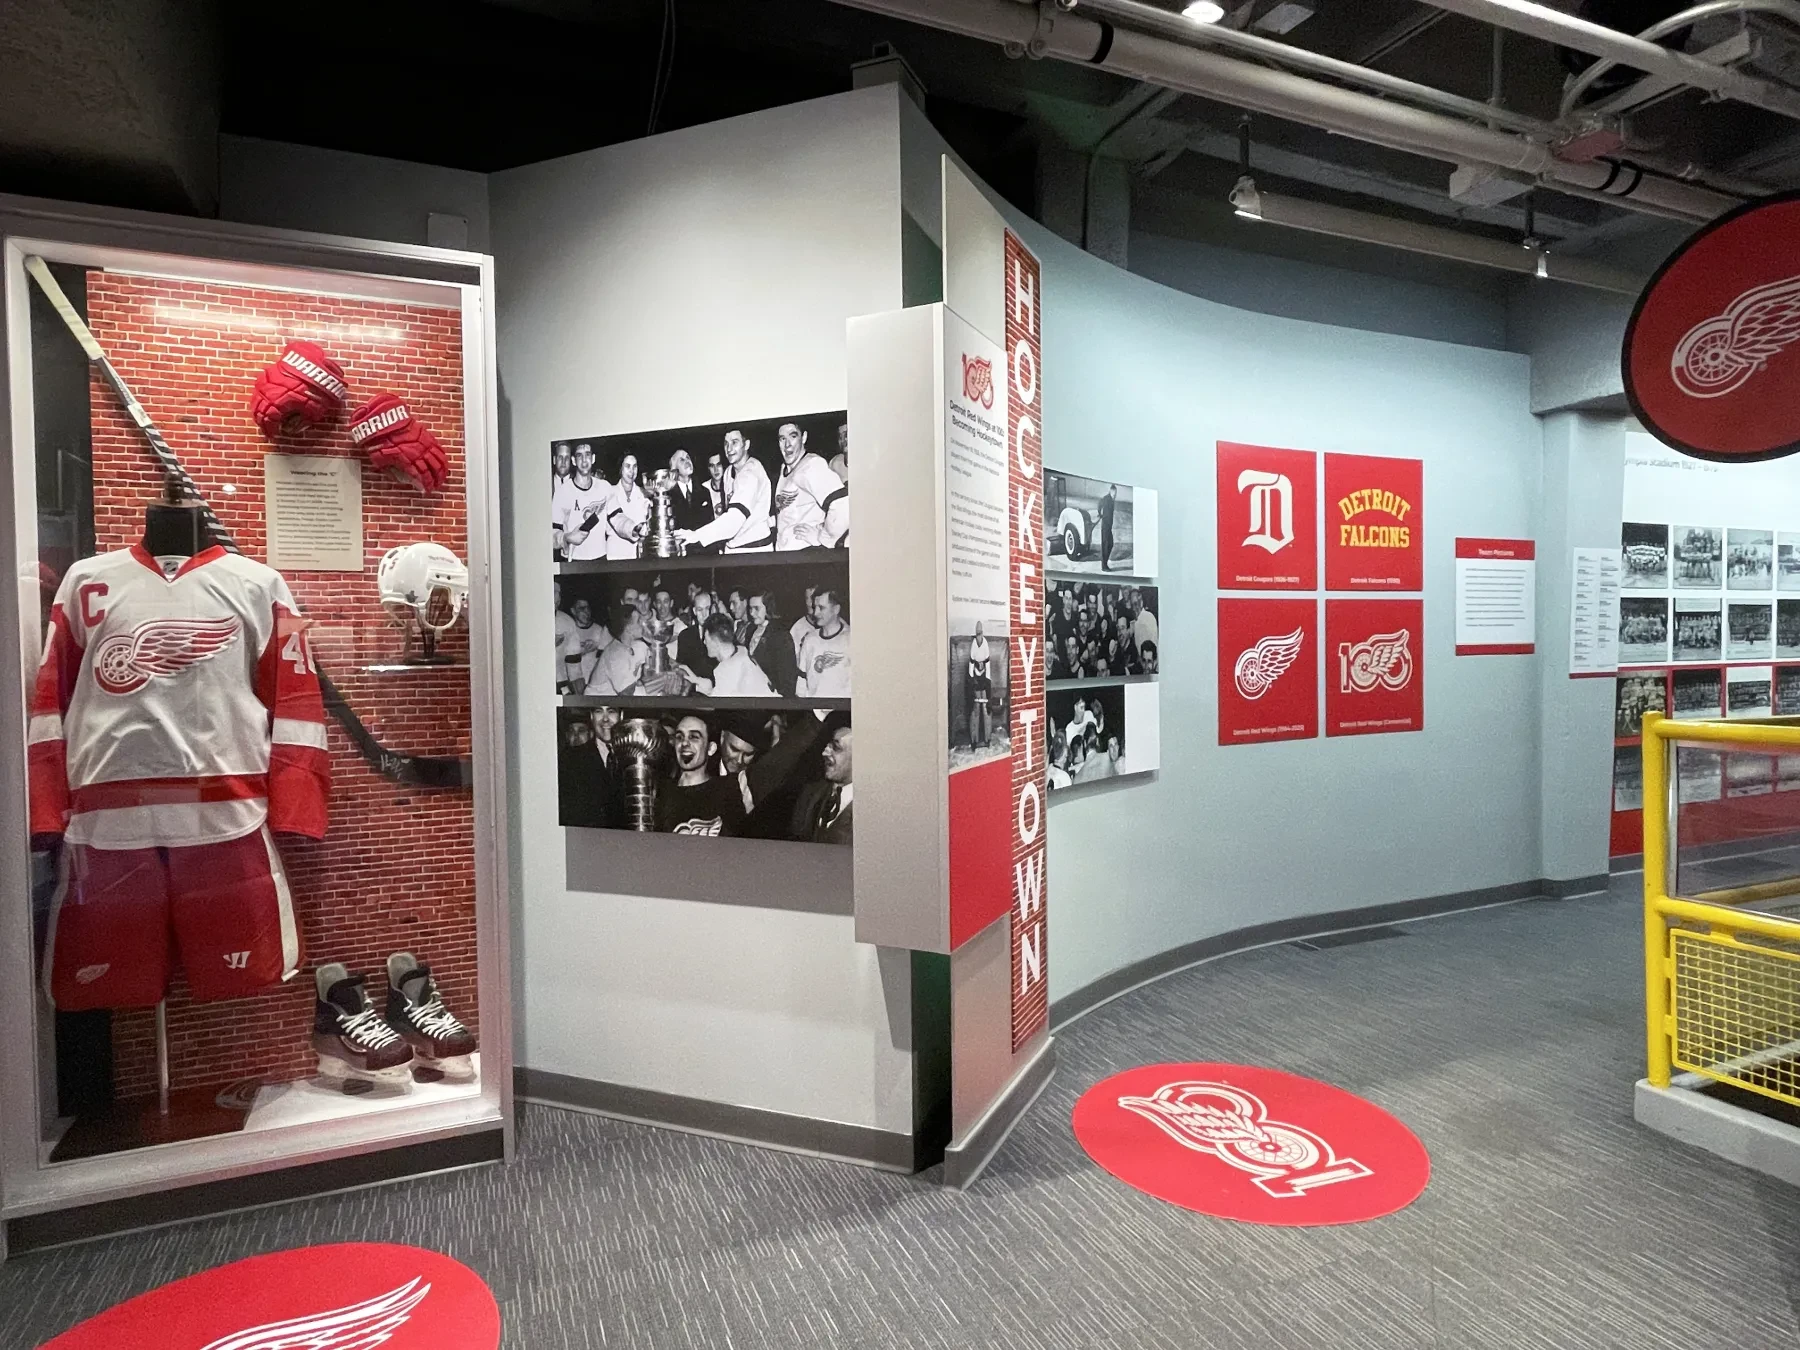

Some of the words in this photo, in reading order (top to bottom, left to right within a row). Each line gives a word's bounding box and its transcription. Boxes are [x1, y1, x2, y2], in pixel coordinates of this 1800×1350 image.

[1338, 489, 1411, 521] DETROIT
[1340, 525, 1410, 548] FALCONS
[79, 582, 109, 628] C
[1014, 258, 1044, 996] HOCKEYTOWN
